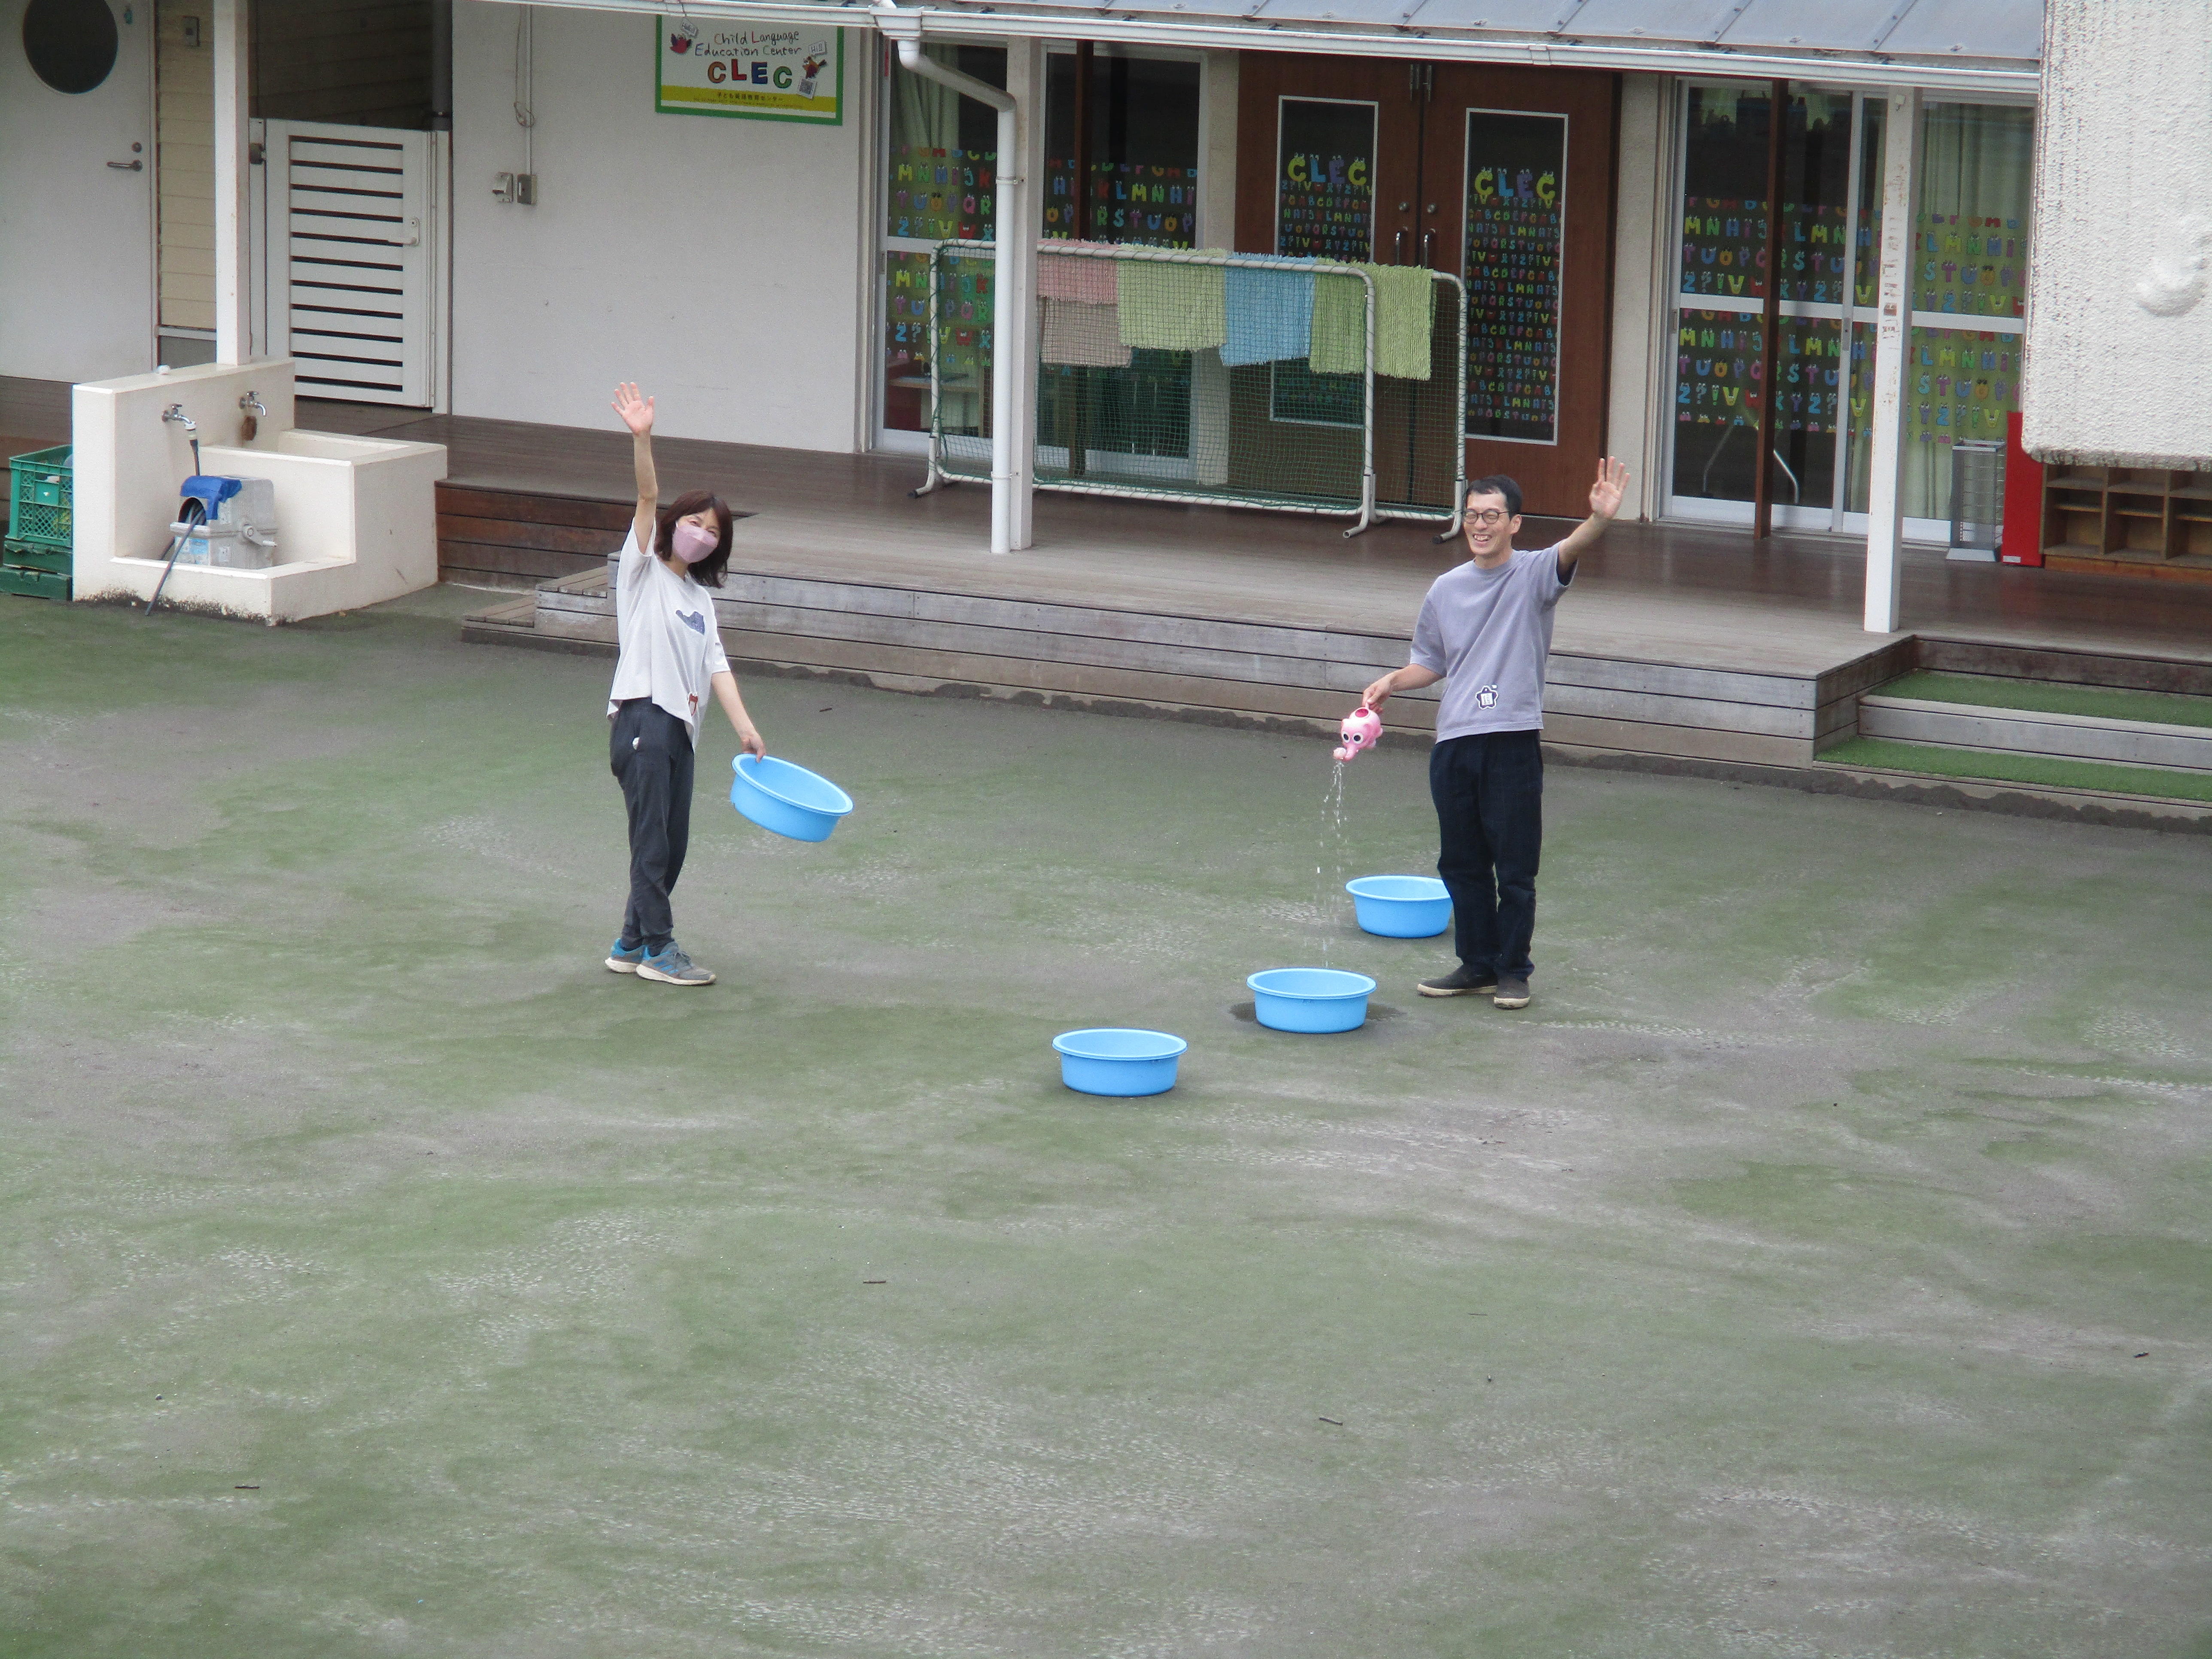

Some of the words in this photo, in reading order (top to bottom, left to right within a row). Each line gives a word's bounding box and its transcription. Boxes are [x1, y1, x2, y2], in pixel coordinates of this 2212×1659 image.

[694, 43, 759, 57] Education
[763, 45, 802, 56] Center
[714, 31, 747, 45] Child
[751, 30, 799, 46] Language
[707, 58, 793, 89] CLEC
[1288, 152, 1367, 186] CLEC
[1475, 166, 1556, 200] CLEC
